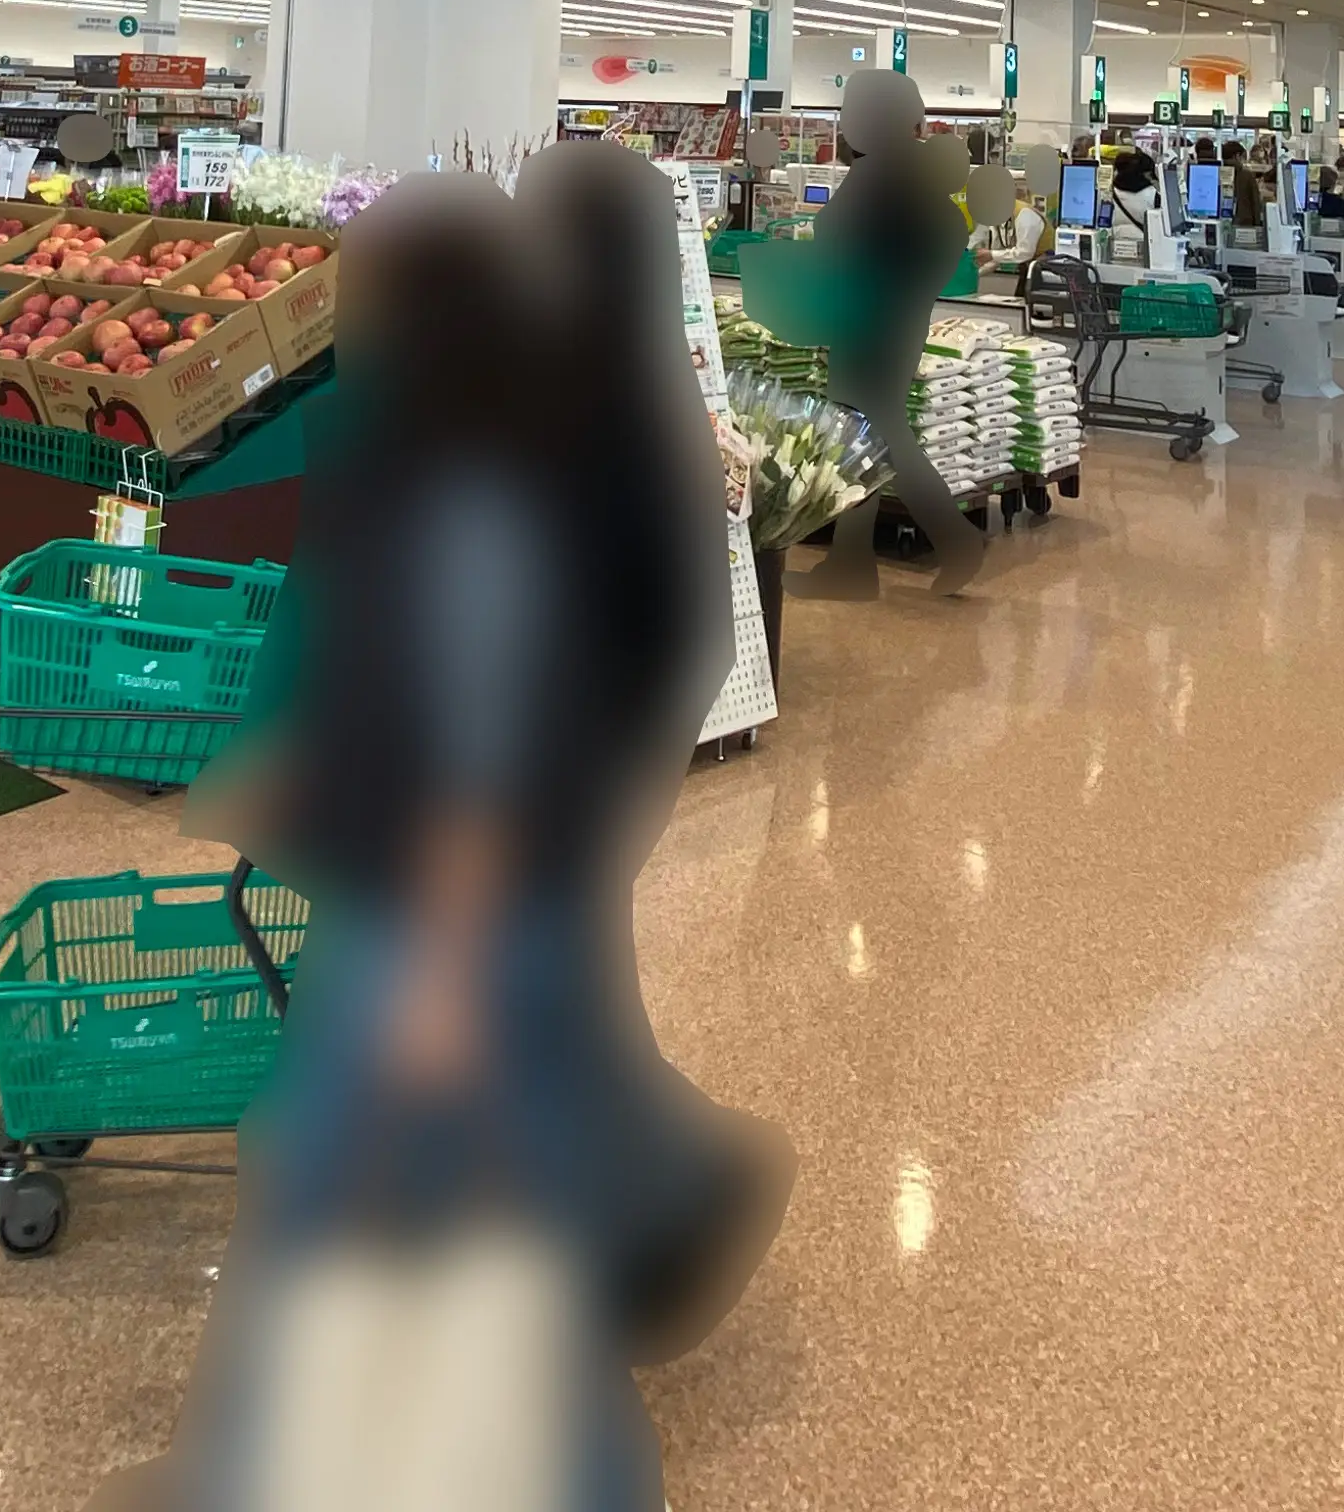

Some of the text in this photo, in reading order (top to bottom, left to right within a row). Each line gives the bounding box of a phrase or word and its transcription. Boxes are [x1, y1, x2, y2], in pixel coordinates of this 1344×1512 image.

[124, 19, 133, 33] 3
[894, 34, 905, 60] 2
[128, 55, 201, 74] お酒コーナー
[1006, 47, 1016, 72] 3
[1096, 59, 1105, 82] 4
[1181, 70, 1189, 91] 5
[1159, 103, 1171, 121] B
[1273, 114, 1284, 128] B
[205, 162, 228, 173] 159
[204, 176, 225, 187] 172
